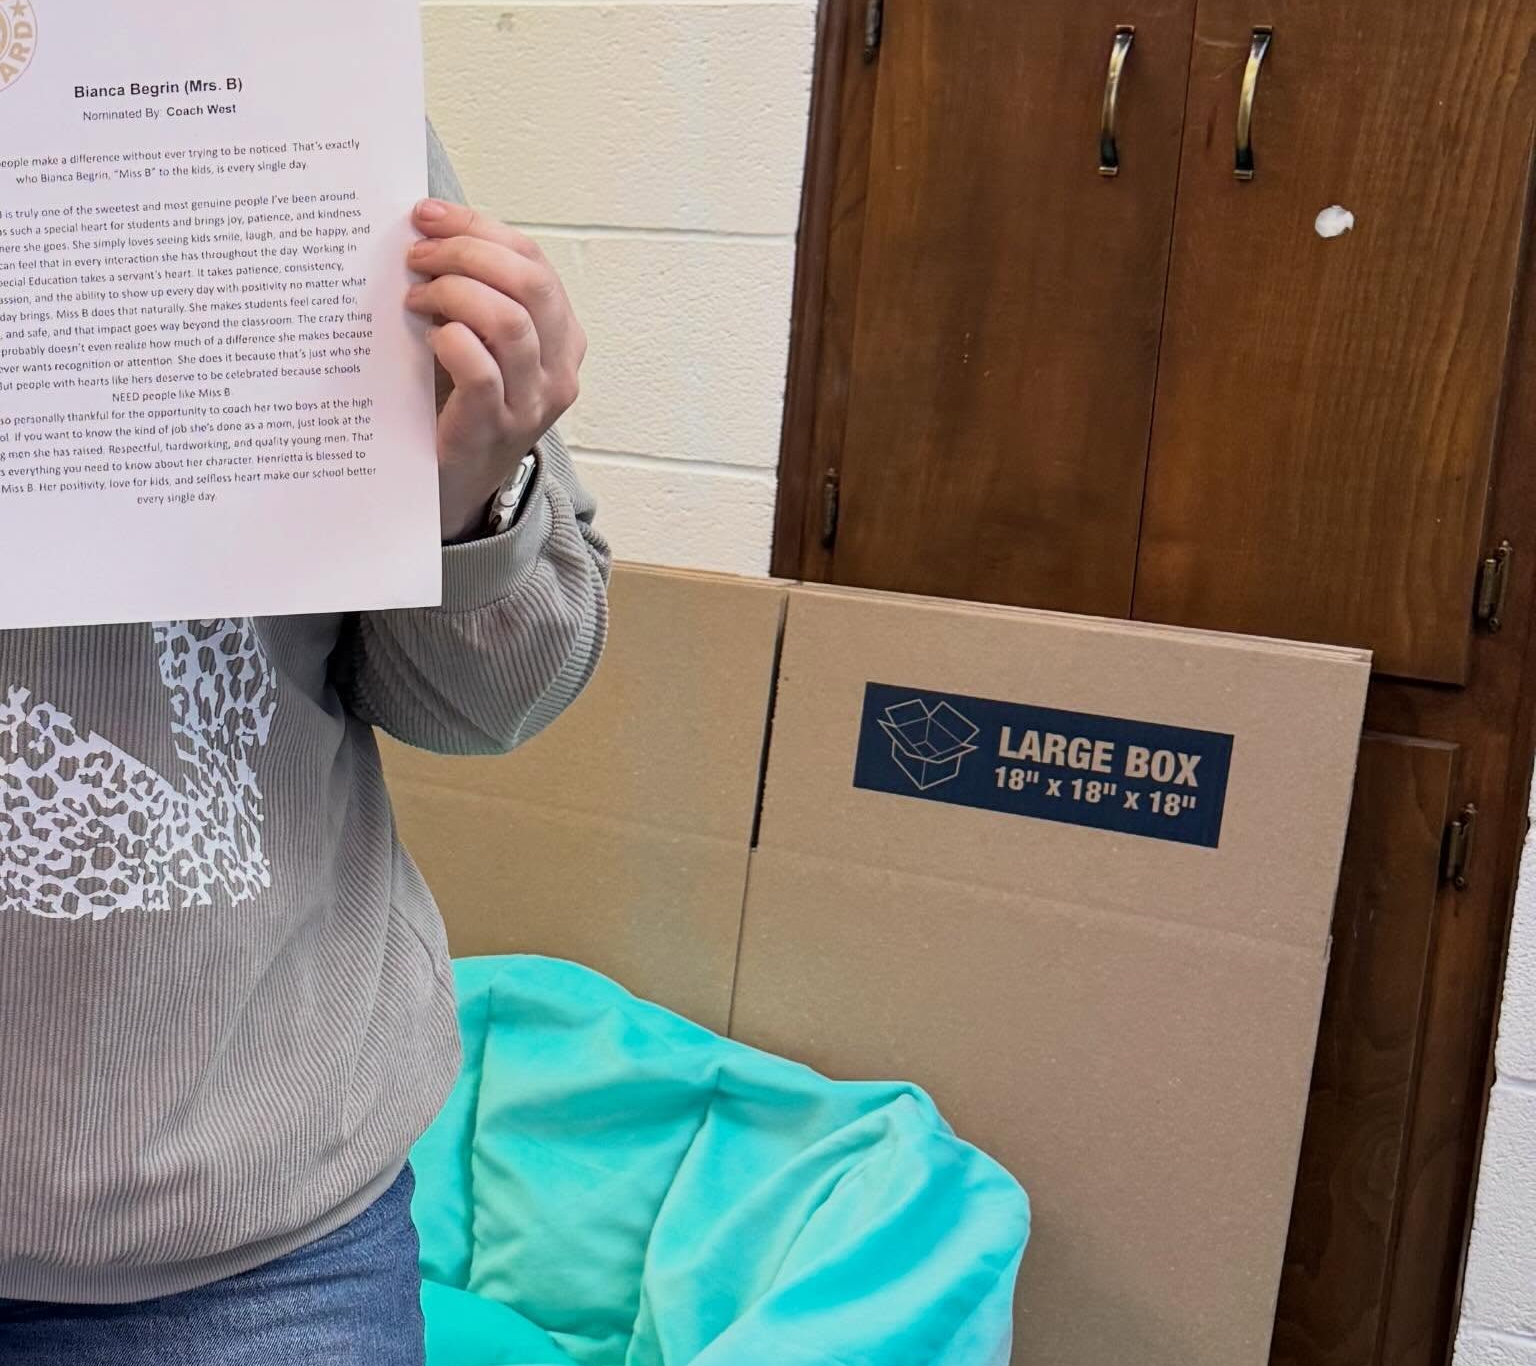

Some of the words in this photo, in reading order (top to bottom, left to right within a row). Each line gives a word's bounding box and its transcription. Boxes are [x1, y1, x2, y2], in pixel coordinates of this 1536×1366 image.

[73, 85, 126, 99] Bianca
[130, 80, 180, 98] Begrin
[184, 79, 223, 97] (Mrs.
[225, 76, 244, 94] B)
[82, 108, 143, 122] Nominated
[166, 104, 204, 118] Coach
[206, 102, 237, 115] West
[31, 155, 59, 167] make
[69, 153, 121, 165] difference
[122, 150, 162, 162] without
[164, 150, 186, 160] ever
[188, 147, 219, 160] trying
[324, 138, 360, 151] exactly
[40, 173, 74, 183] Bianca
[227, 164, 256, 174] every
[257, 160, 287, 173] single
[15, 207, 40, 220] truly
[95, 203, 141, 215] sweetest
[163, 201, 189, 211] most
[191, 198, 232, 212] genuine
[234, 195, 269, 209] people
[291, 194, 317, 204] been
[9, 224, 33, 236] such
[43, 222, 79, 236] special
[80, 222, 109, 232] heart
[127, 218, 171, 230] students
[194, 215, 225, 228] brings
[317, 207, 362, 219] kindness
[43, 242, 70, 254] goes.
[93, 237, 126, 251] simply
[128, 236, 155, 247] loves
[156, 235, 190, 247] seeing
[190, 232, 212, 244] kids
[18, 259, 37, 270] feel
[39, 258, 60, 269] that
[74, 258, 102, 268] every
[104, 253, 160, 266] interaction
[201, 248, 259, 262] throughout
[302, 243, 345, 255] Working
[28, 275, 78, 287] Education
[80, 273, 107, 284] takes
[207, 266, 234, 277] takes
[75, 290, 106, 302] ability
[121, 288, 149, 299] show
[165, 287, 195, 298] every
[216, 282, 240, 294] with
[241, 281, 288, 295] positivity
[305, 279, 340, 289] matter
[341, 276, 367, 288] what
[56, 309, 80, 320] Miss
[91, 306, 116, 318] does
[117, 306, 138, 316] that
[210, 300, 243, 312] makes
[244, 298, 289, 311] students
[290, 296, 309, 308] feel
[311, 294, 340, 307] cared
[74, 325, 95, 336] that
[97, 324, 132, 336] impact
[134, 323, 158, 335] goes
[182, 318, 221, 332] beyond
[318, 314, 345, 324] crazy
[346, 310, 373, 323] thing
[1, 344, 46, 359] probably
[87, 343, 113, 353] even
[114, 339, 147, 351] realize
[173, 336, 202, 348] much
[225, 333, 276, 346] difference
[298, 330, 330, 342] makes
[332, 330, 373, 340] because
[22, 363, 53, 373] wants
[54, 359, 112, 372] recognition
[198, 354, 224, 364] does
[234, 351, 276, 363] because
[309, 348, 327, 360] just
[16, 379, 51, 392] people
[52, 378, 76, 388] with
[77, 377, 110, 387] hearts
[111, 374, 129, 386] like
[131, 374, 154, 385] hers
[155, 373, 195, 383] deserve
[225, 366, 279, 380] celebrated
[280, 366, 322, 377] because
[324, 363, 361, 375] schools
[112, 391, 141, 403] NEED
[142, 389, 177, 403] people
[13, 412, 66, 427] personally
[67, 410, 109, 422] thankful
[147, 406, 207, 420] opportunity
[222, 403, 252, 415] coach
[295, 400, 319, 412] boys
[352, 397, 374, 410] high
[254, 435, 290, 449] quality
[290, 436, 322, 448] young
[351, 432, 374, 443] That
[7, 464, 62, 477] everything
[154, 458, 185, 470] about
[256, 453, 304, 465] Henrietta
[315, 448, 354, 462] blessed
[1, 483, 25, 494] Miss
[109, 478, 131, 489] love
[196, 473, 233, 485] selfless
[234, 472, 261, 483] heart
[263, 470, 291, 481] make
[312, 466, 345, 479] school
[346, 466, 377, 477] better
[136, 495, 165, 505] every
[167, 491, 196, 505] single
[998, 726, 1114, 773] LARGE
[1125, 746, 1201, 787] BOX
[994, 766, 1039, 791] 18"
[1046, 779, 1061, 797] x
[1071, 778, 1117, 804] 18"
[1123, 792, 1139, 809] x
[1149, 792, 1196, 817] 18"
